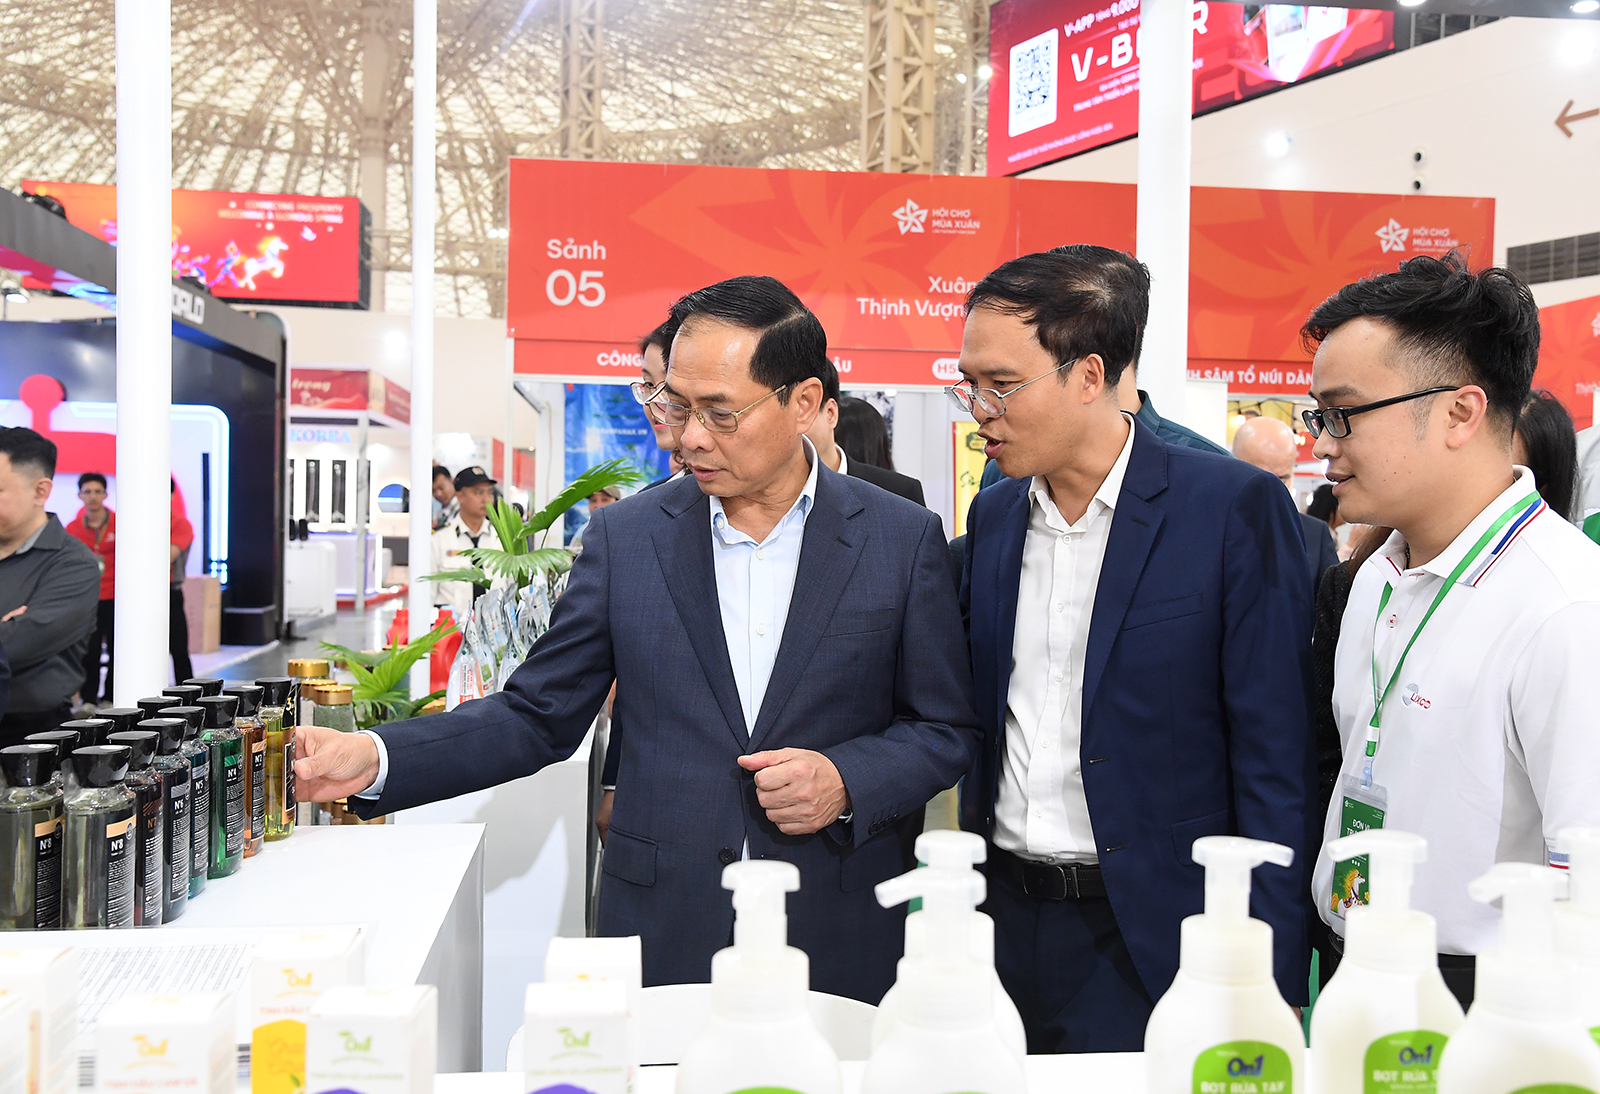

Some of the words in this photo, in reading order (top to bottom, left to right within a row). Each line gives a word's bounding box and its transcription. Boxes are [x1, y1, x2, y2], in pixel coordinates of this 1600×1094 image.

[1071, 26, 1141, 82] V-B
[547, 238, 606, 260] Sảnh
[546, 269, 606, 307] 05
[856, 297, 910, 320] Thịnh
[915, 299, 966, 321] Vượn
[597, 350, 642, 367] CÔNG
[1204, 367, 1234, 384] SÂM
[1237, 364, 1256, 384] TỔ
[1259, 368, 1282, 385] NÚI
[290, 428, 352, 443] KOREA
